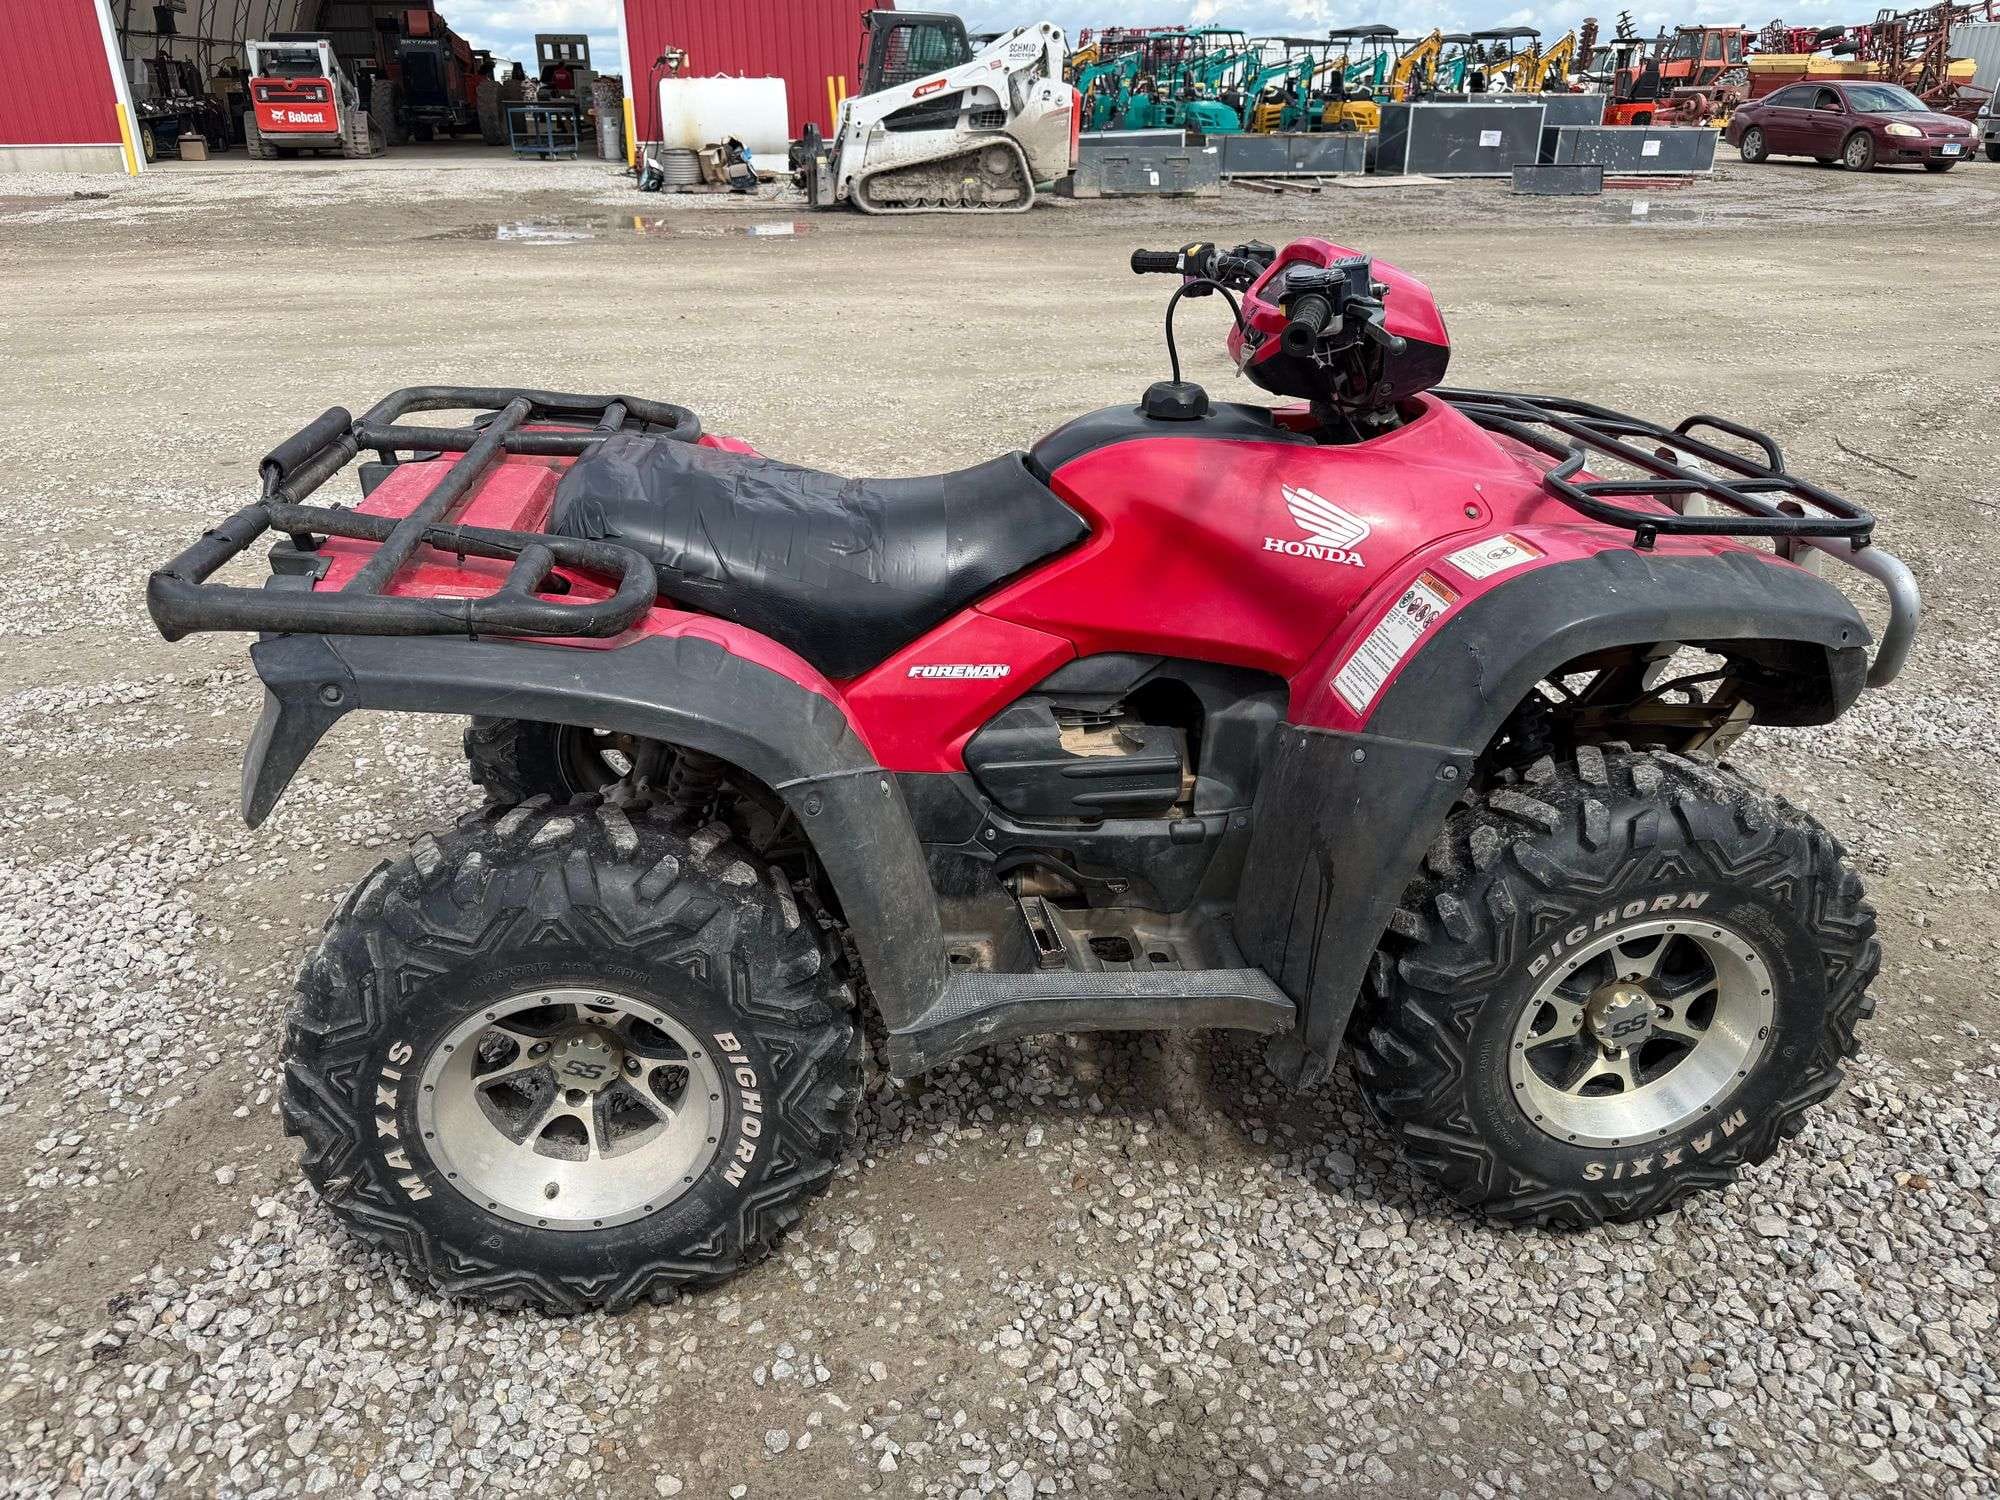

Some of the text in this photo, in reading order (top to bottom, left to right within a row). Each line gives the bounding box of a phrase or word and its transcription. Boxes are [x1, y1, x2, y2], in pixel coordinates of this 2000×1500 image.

[1009, 43, 1037, 53] SCHMID
[287, 111, 324, 123] Bobcat
[1262, 537, 1366, 568] HONDA
[907, 664, 1011, 679] FOREMAN
[1527, 892, 1711, 978] BIGHORN
[1611, 1012, 1649, 1039] SS
[563, 1060, 607, 1080] SS
[375, 1040, 433, 1201] MAXXIS
[713, 1032, 763, 1188] BIGHORN
[1582, 1109, 1747, 1181] MAXXIS
